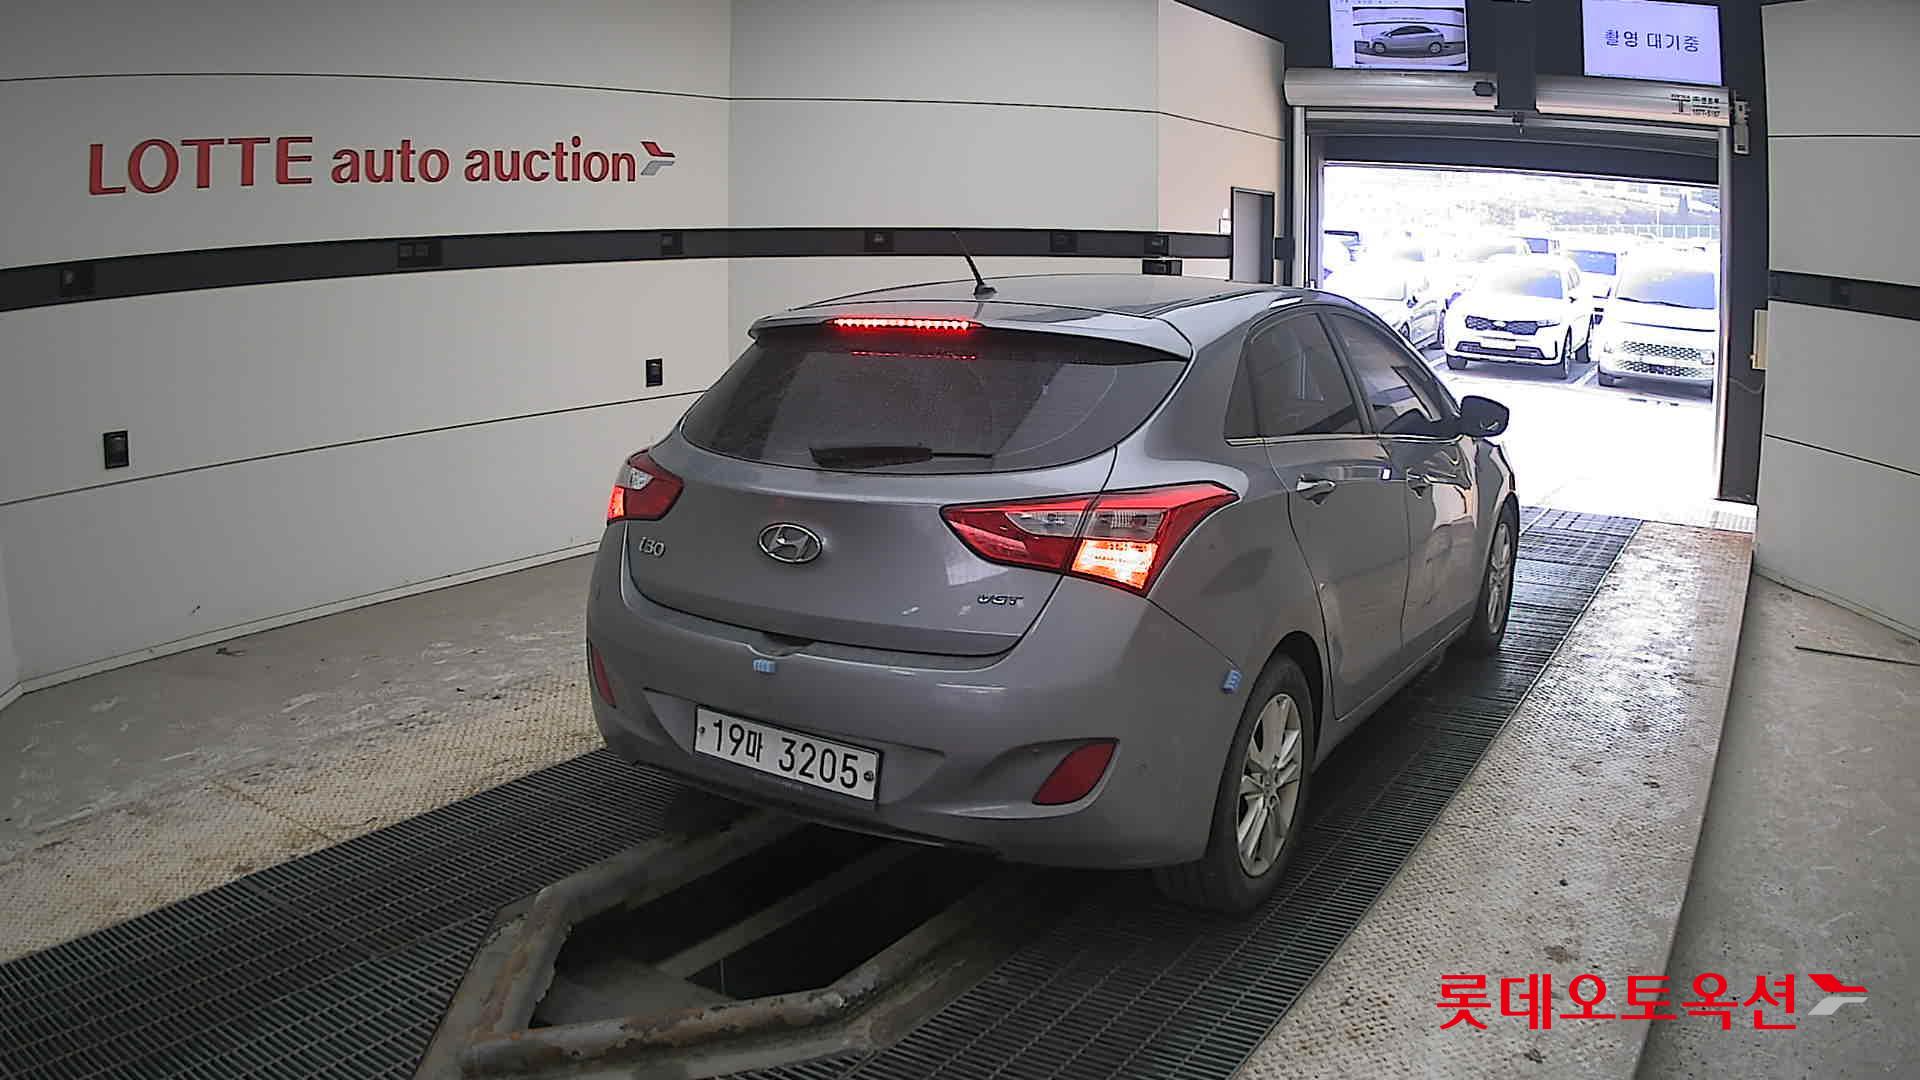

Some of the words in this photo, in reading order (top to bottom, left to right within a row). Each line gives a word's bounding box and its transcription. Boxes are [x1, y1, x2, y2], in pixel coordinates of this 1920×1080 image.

[1647, 32, 1699, 52] 대기중
[89, 136, 313, 196] LOTTE
[331, 138, 450, 184] auto
[464, 136, 637, 183] auction
[713, 719, 763, 763] 19마
[778, 737, 858, 789] 3205
